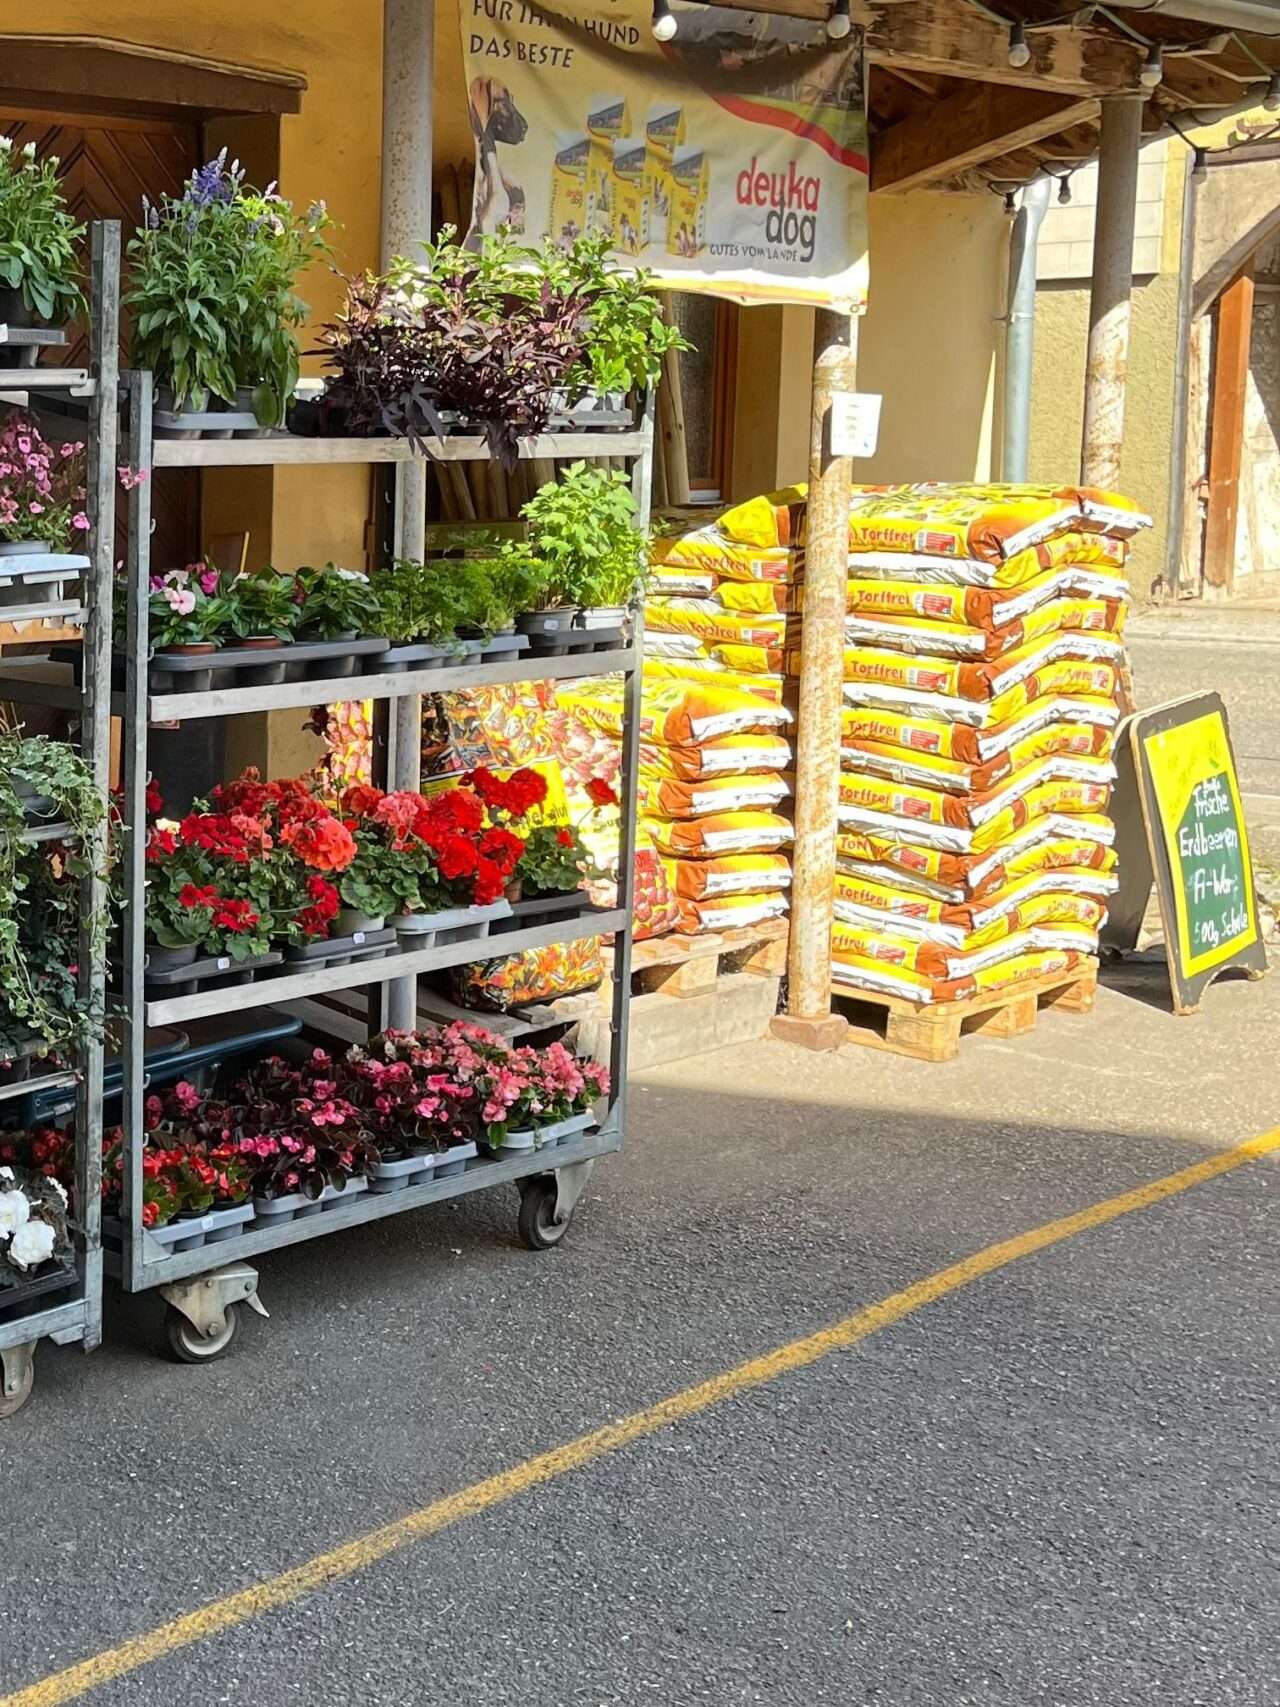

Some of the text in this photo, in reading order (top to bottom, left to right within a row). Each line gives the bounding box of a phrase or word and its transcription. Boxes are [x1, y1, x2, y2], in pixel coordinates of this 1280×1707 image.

[584, 19, 640, 46] HUND
[470, 34, 575, 68] DAS BESTE
[736, 156, 821, 212] deuka
[766, 190, 817, 263] dog
[710, 244, 798, 262] GUTES VOM LANDE
[851, 661, 903, 679] Torffrei
[838, 784, 889, 804] Torffrei
[1179, 822, 1239, 857] Erdbeeren
[838, 883, 888, 907] Torffrei
[1193, 919, 1220, 948] 500g
